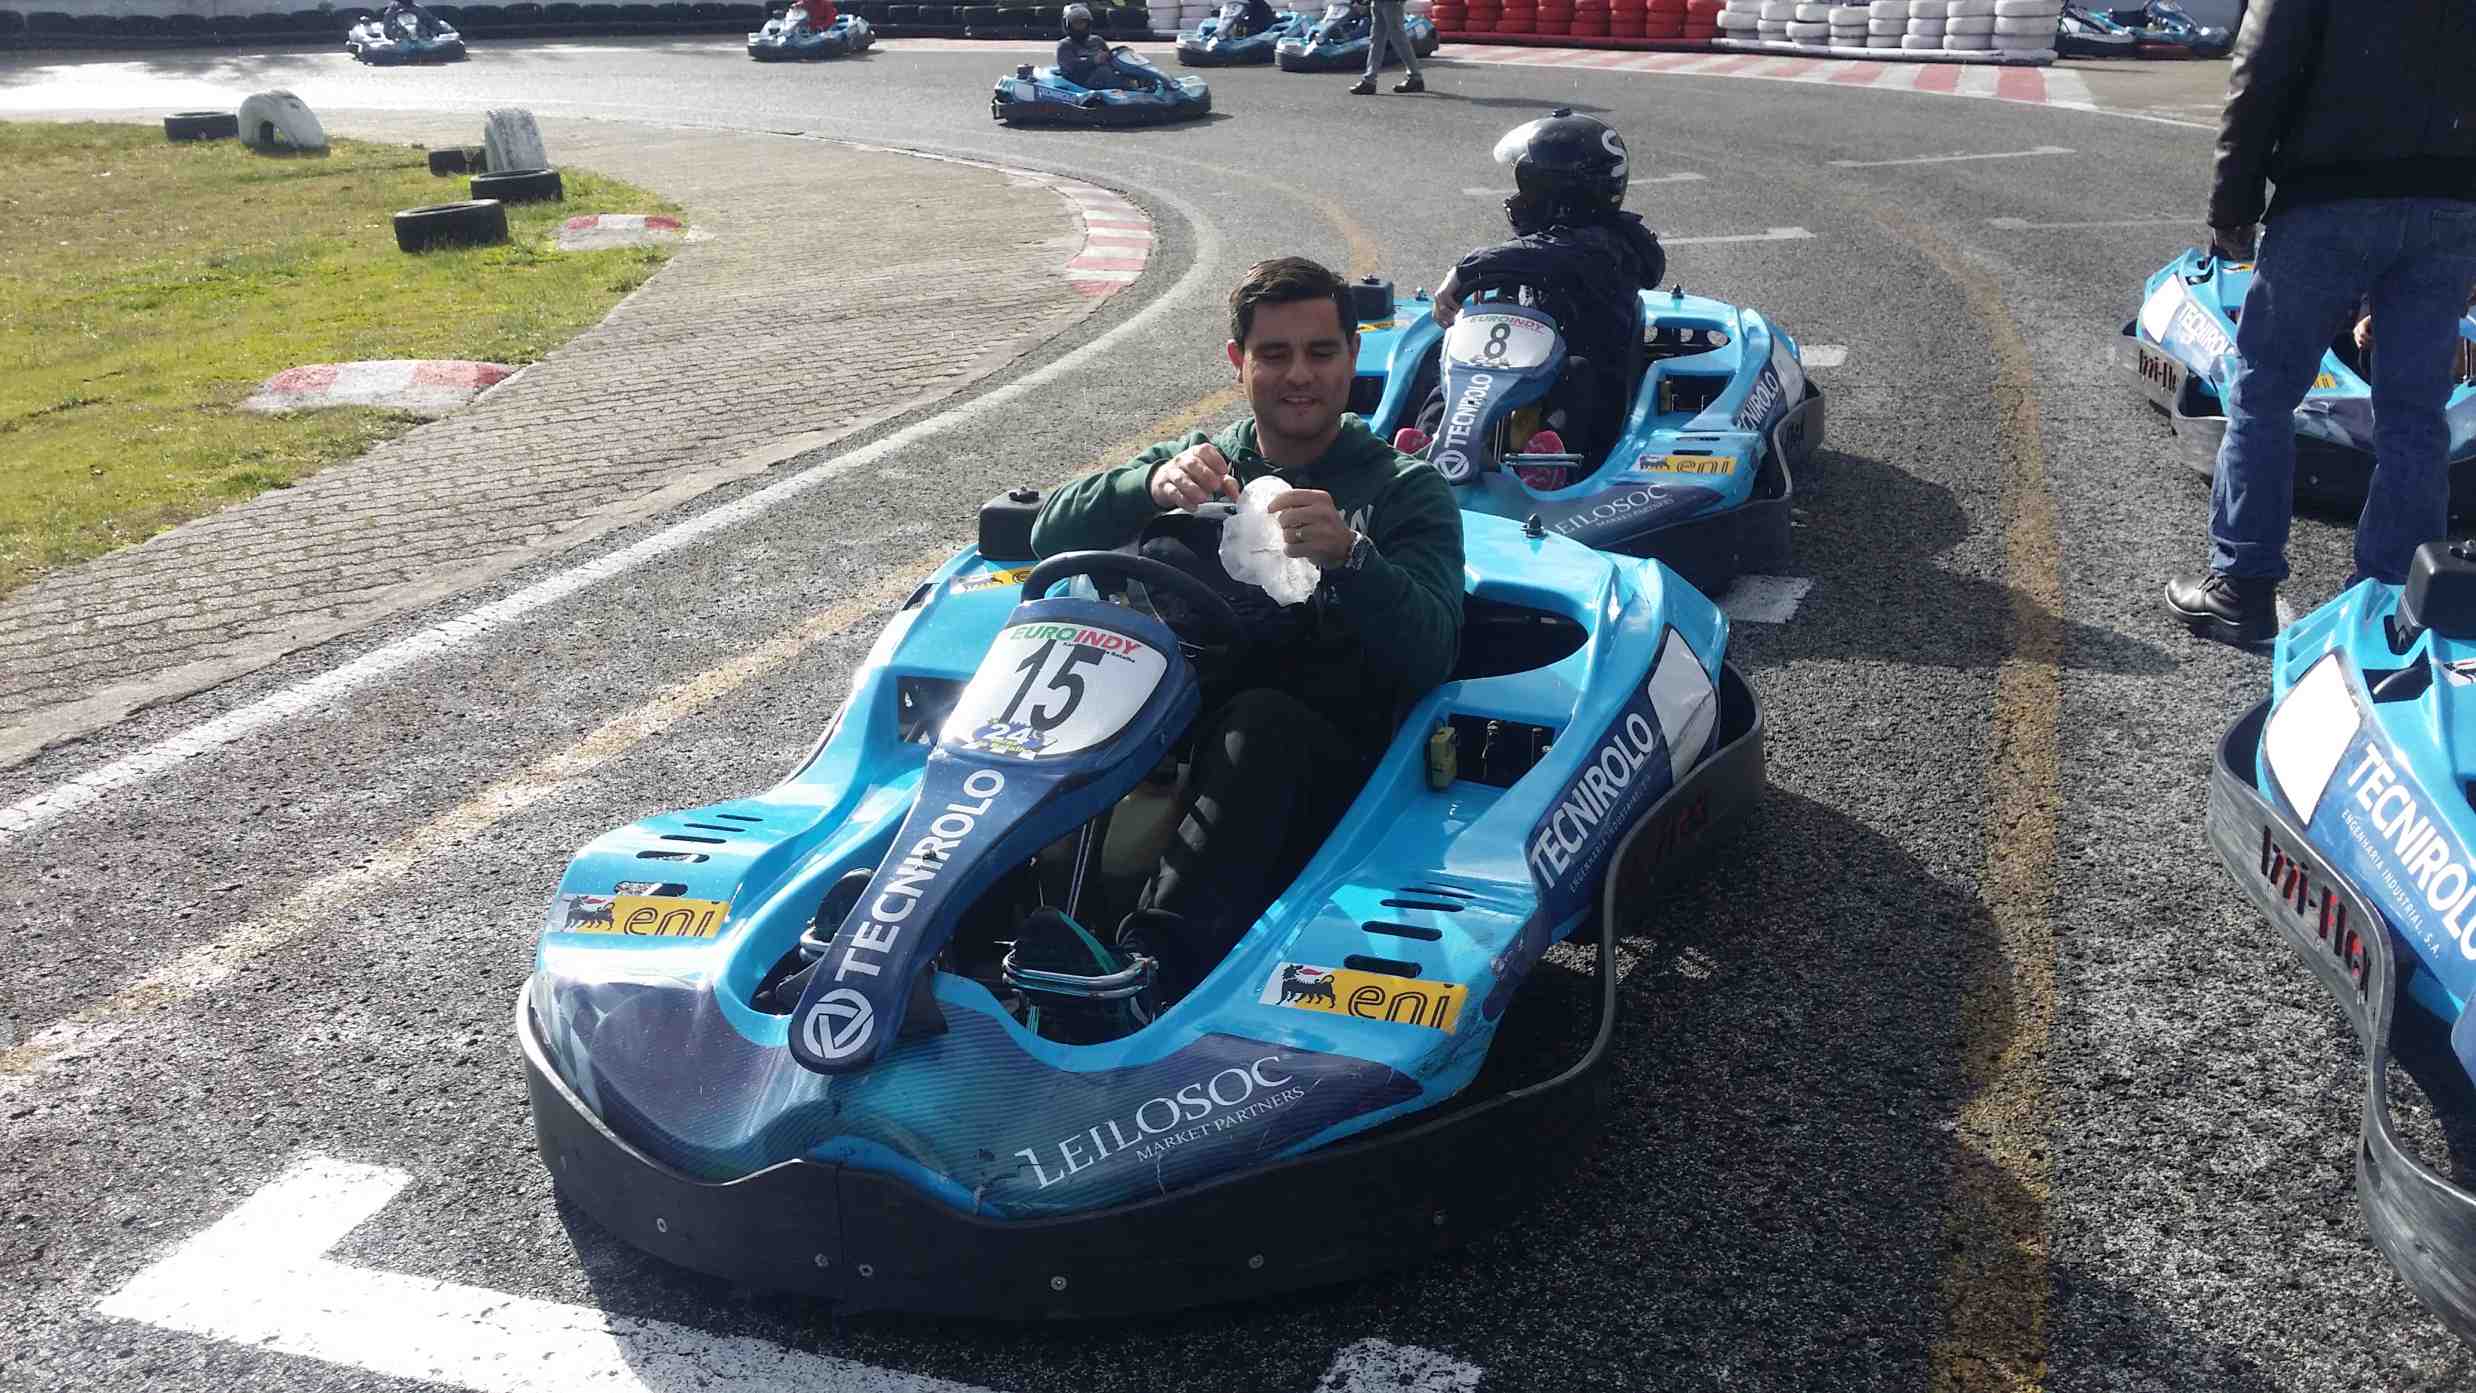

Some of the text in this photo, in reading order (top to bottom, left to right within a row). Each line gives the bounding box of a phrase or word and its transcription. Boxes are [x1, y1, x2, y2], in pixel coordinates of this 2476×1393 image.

[1483, 322, 1511, 359] 8
[1444, 373, 1494, 448] TECNIROLO
[1738, 371, 1779, 431] CNIROLO
[1675, 454, 1729, 474] eni
[1554, 484, 1669, 535] EILOSOC
[1009, 625, 1142, 655] EUROINDY
[1001, 639, 1107, 732] 15
[1531, 712, 1654, 889] TECNIROLO
[834, 768, 1006, 983] TECNIROLO
[623, 900, 718, 937] eni
[1348, 983, 1456, 1029] eni
[1014, 1056, 1293, 1190] LEILOSOC
[1136, 1086, 1305, 1162] MARKET PARTNERS
